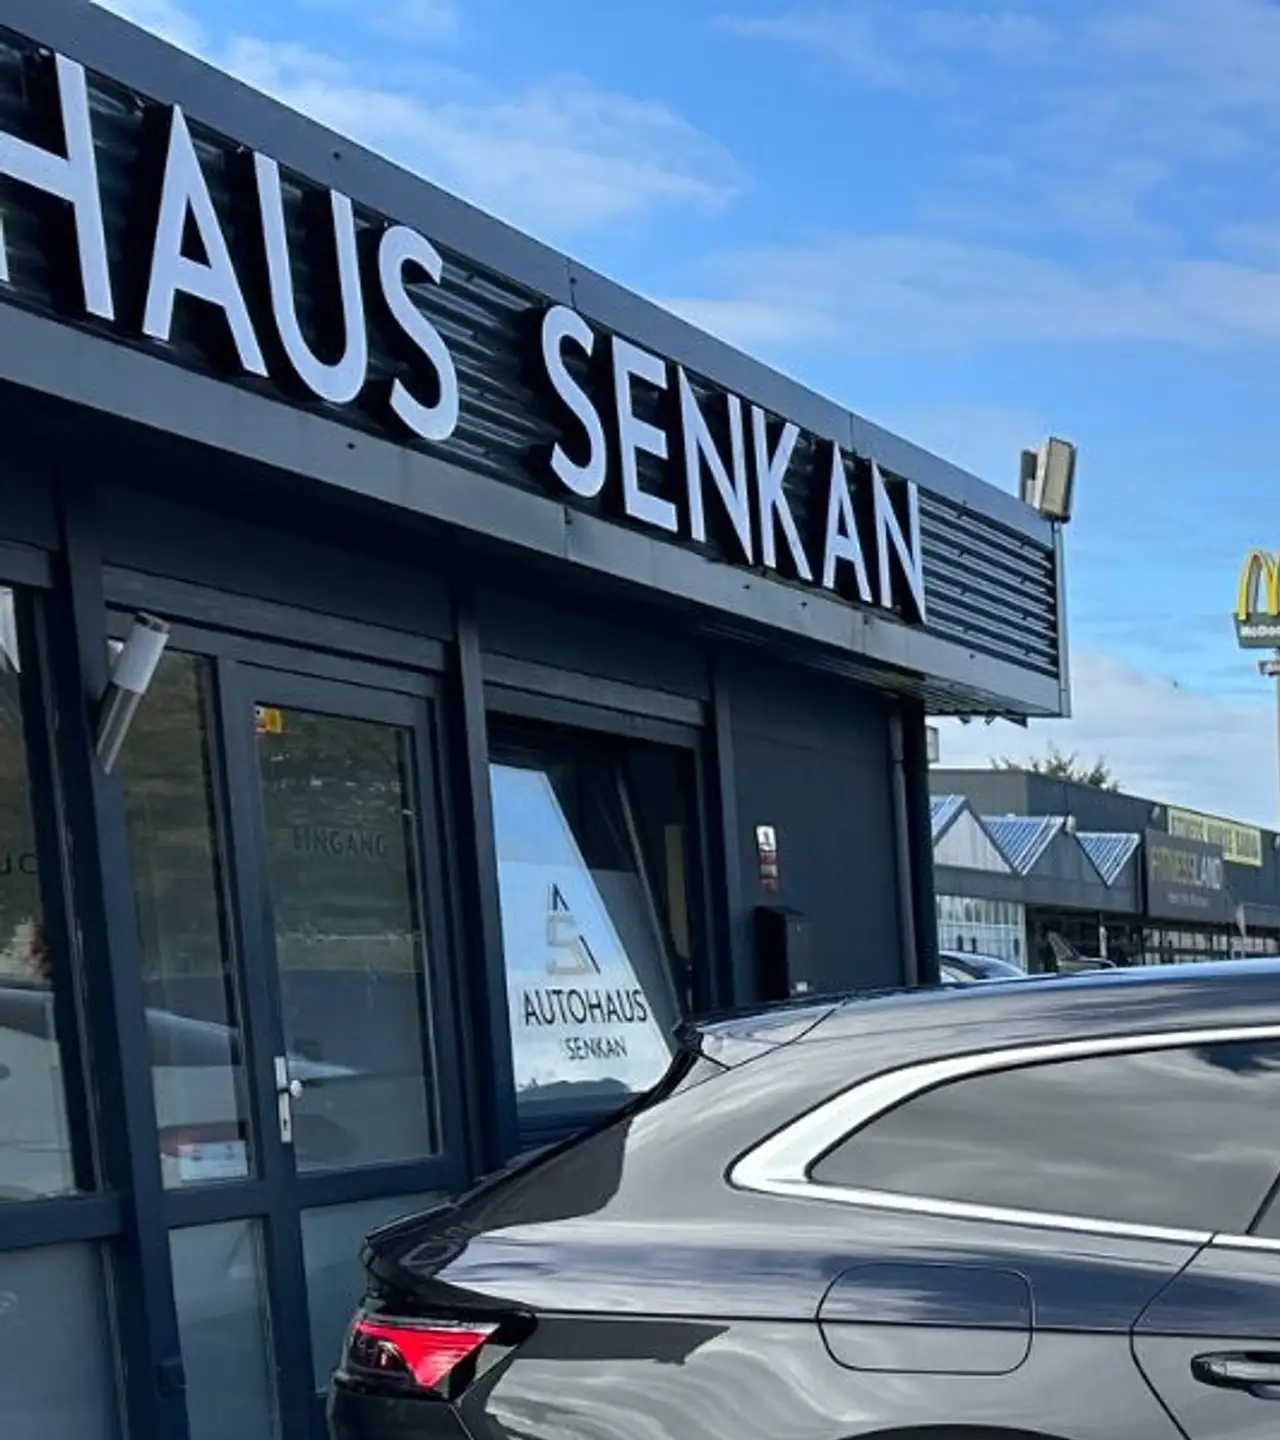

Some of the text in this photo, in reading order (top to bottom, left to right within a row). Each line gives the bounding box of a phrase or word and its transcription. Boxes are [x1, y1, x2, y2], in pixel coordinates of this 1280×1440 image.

[0, 53, 927, 623] HAUS SENKAN
[523, 988, 648, 1027] AUTOHAUS
[563, 1036, 628, 1060] SENKAN
